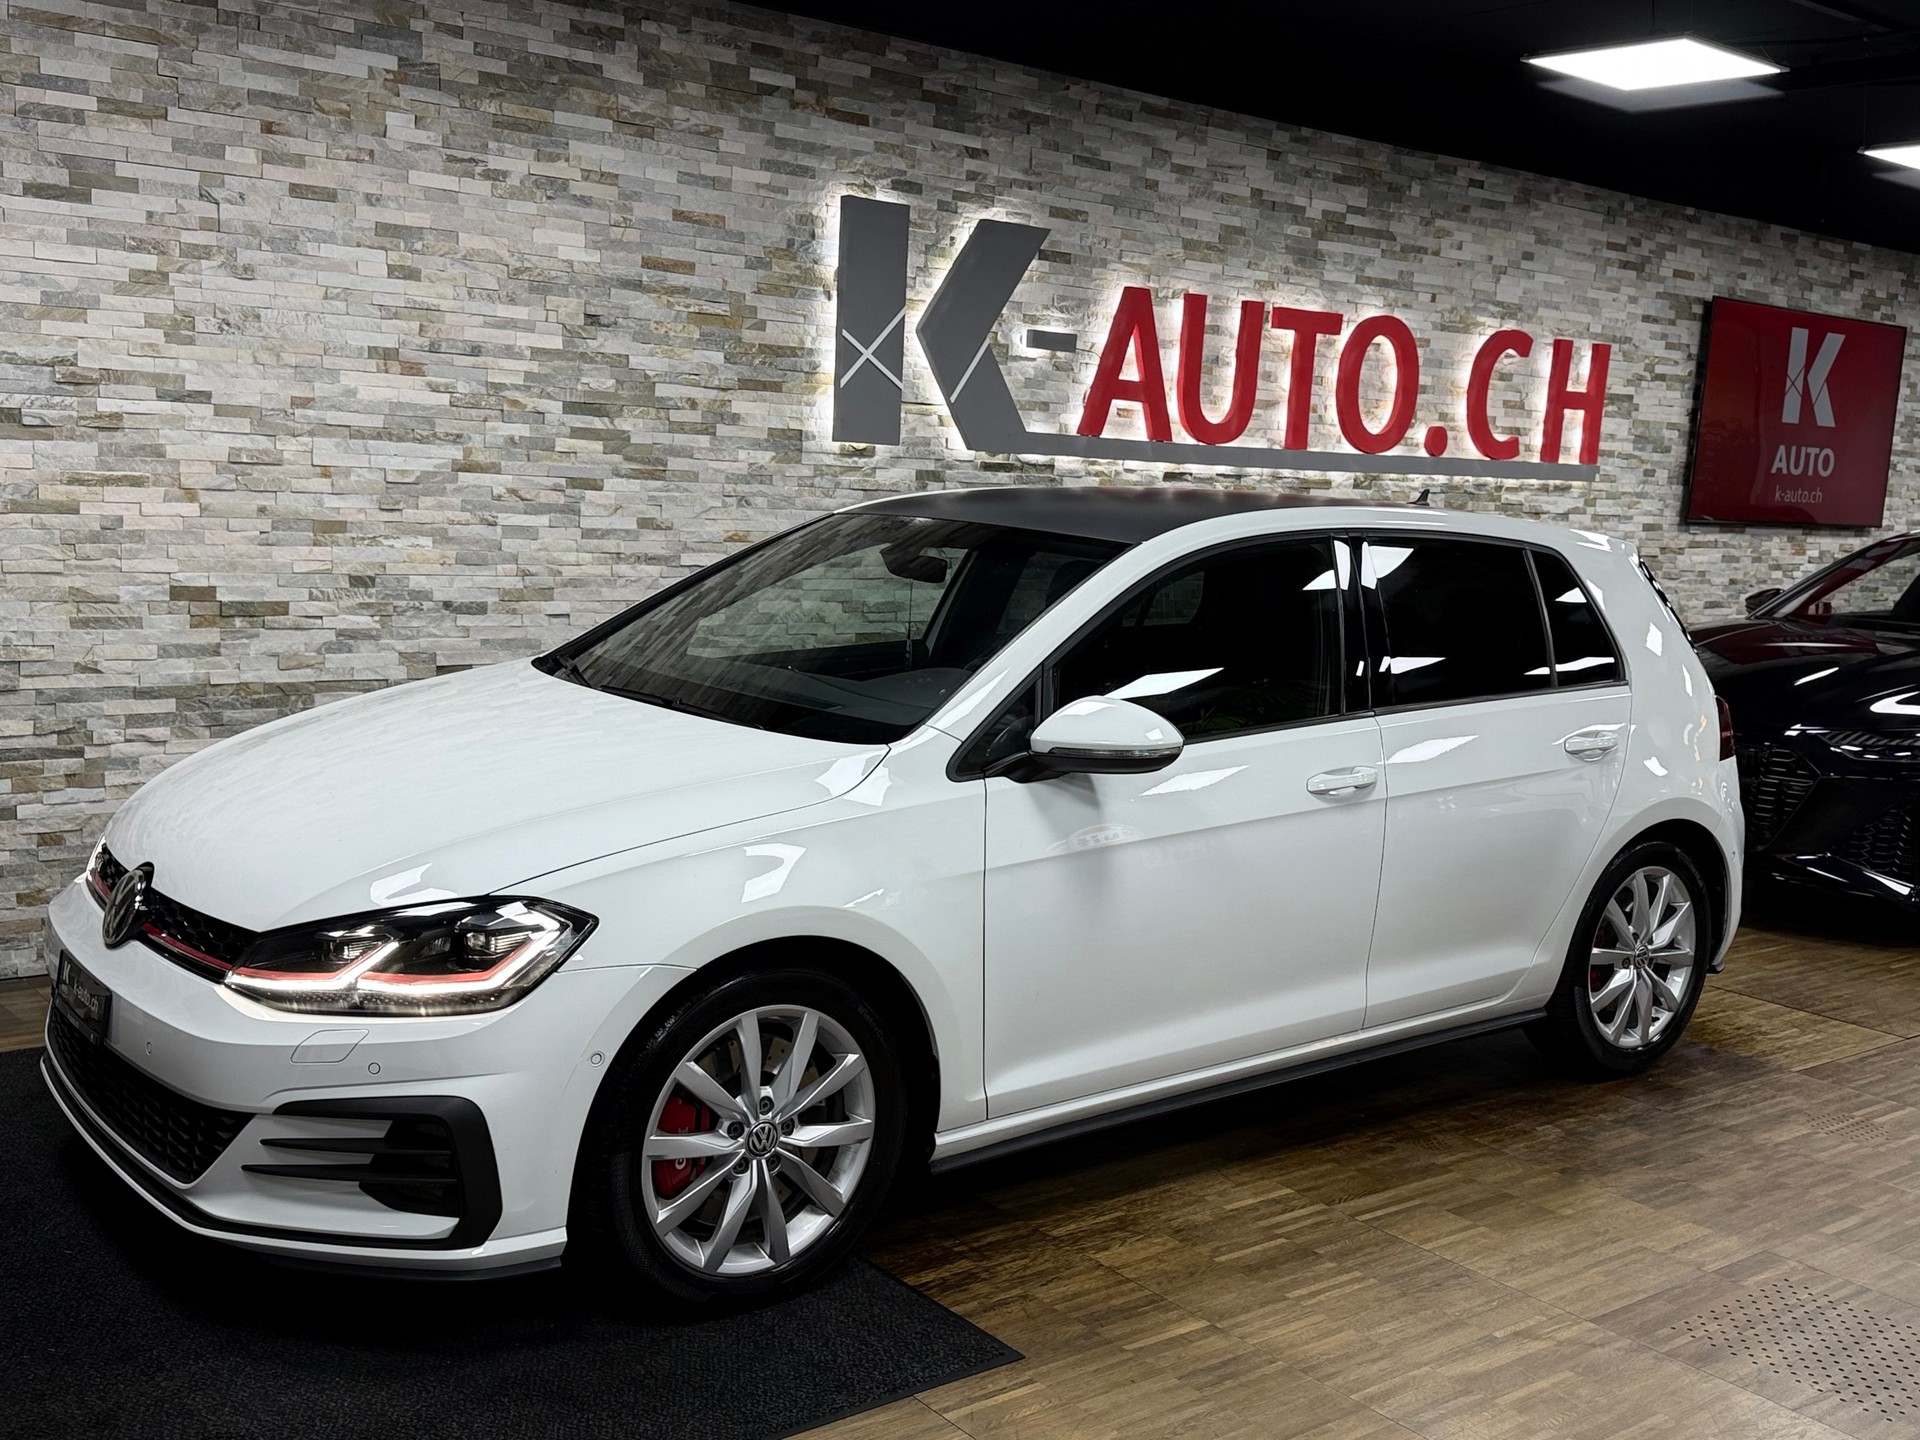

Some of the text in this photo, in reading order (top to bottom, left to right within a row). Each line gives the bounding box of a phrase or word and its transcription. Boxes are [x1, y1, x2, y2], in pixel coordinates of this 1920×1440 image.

[832, 194, 1612, 480] K-AUTO.CH
[1781, 326, 1847, 428] K
[1770, 445, 1835, 477] AUTO
[1774, 485, 1823, 504] k-auto.ch
